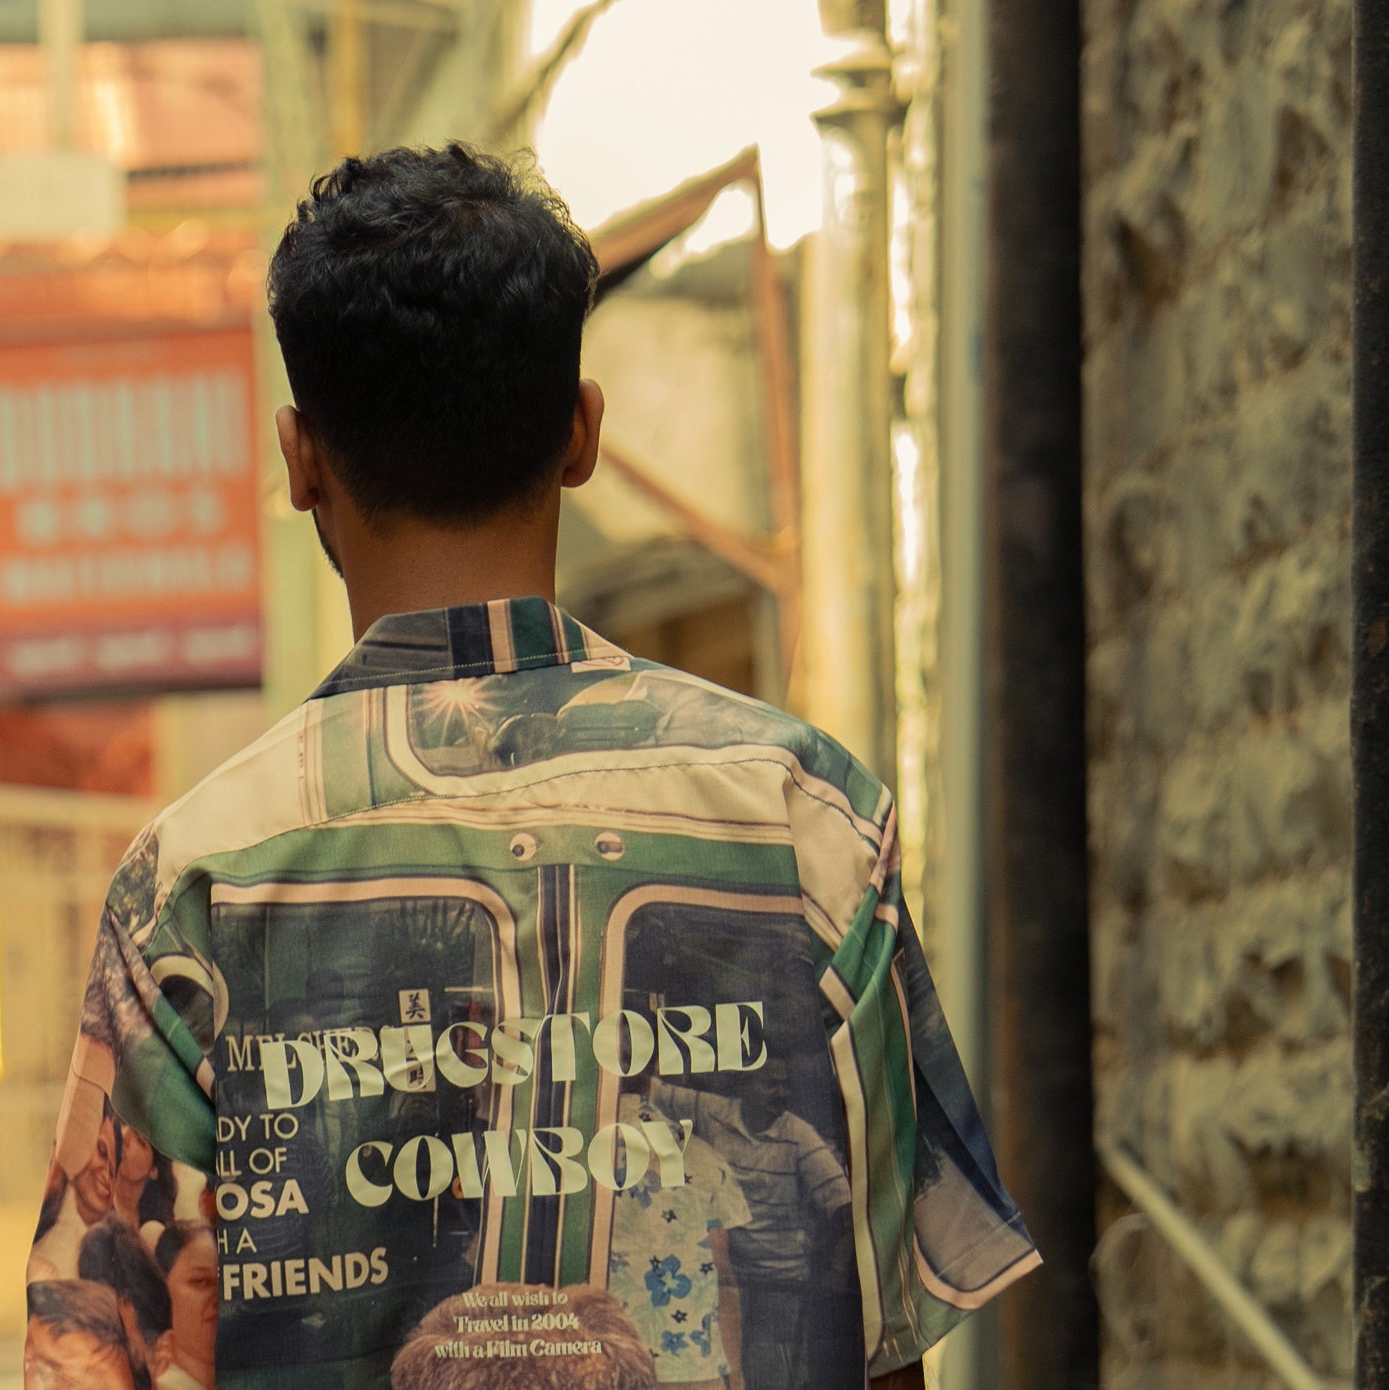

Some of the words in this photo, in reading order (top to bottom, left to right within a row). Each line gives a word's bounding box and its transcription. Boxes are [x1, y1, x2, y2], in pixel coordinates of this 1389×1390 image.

[262, 1001, 767, 1110] DRUGSTORE
[216, 1114, 252, 1142] DY
[259, 1113, 299, 1140] TO
[248, 1147, 287, 1174] OF
[346, 1119, 693, 1207] COWBOY
[236, 1227, 257, 1254] A
[462, 1292, 487, 1308] We
[489, 1291, 507, 1307] all
[511, 1291, 549, 1306] wish
[552, 1291, 568, 1305] to
[453, 1314, 508, 1333] Travel
[511, 1314, 529, 1332] in
[531, 1312, 580, 1331] 2004
[435, 1341, 469, 1359] with
[472, 1344, 484, 1358] a
[486, 1339, 527, 1358] Film
[529, 1339, 602, 1356] Camera
